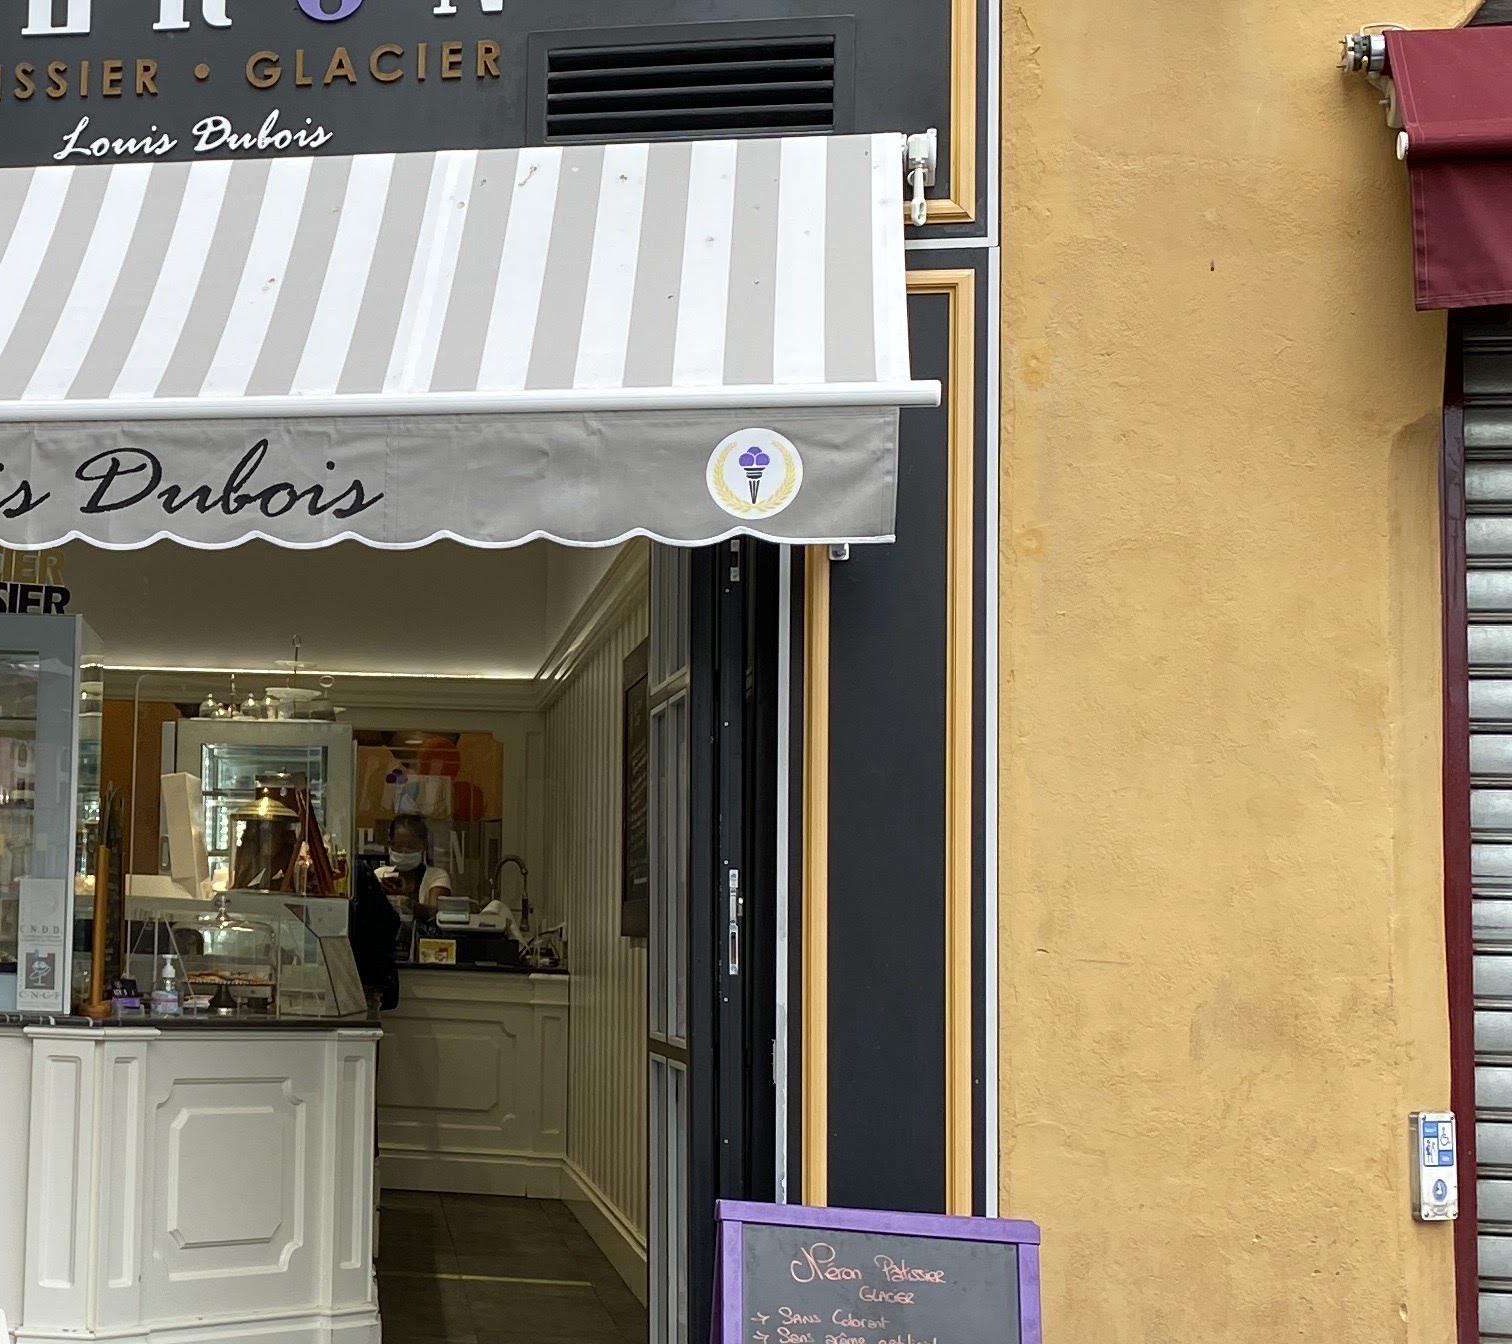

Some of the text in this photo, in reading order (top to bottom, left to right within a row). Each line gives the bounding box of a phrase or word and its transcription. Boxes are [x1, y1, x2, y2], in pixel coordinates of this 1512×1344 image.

[245, 38, 501, 88] GLACIER
[53, 108, 333, 160] Louis Dubois
[75, 438, 384, 518] Dubois
